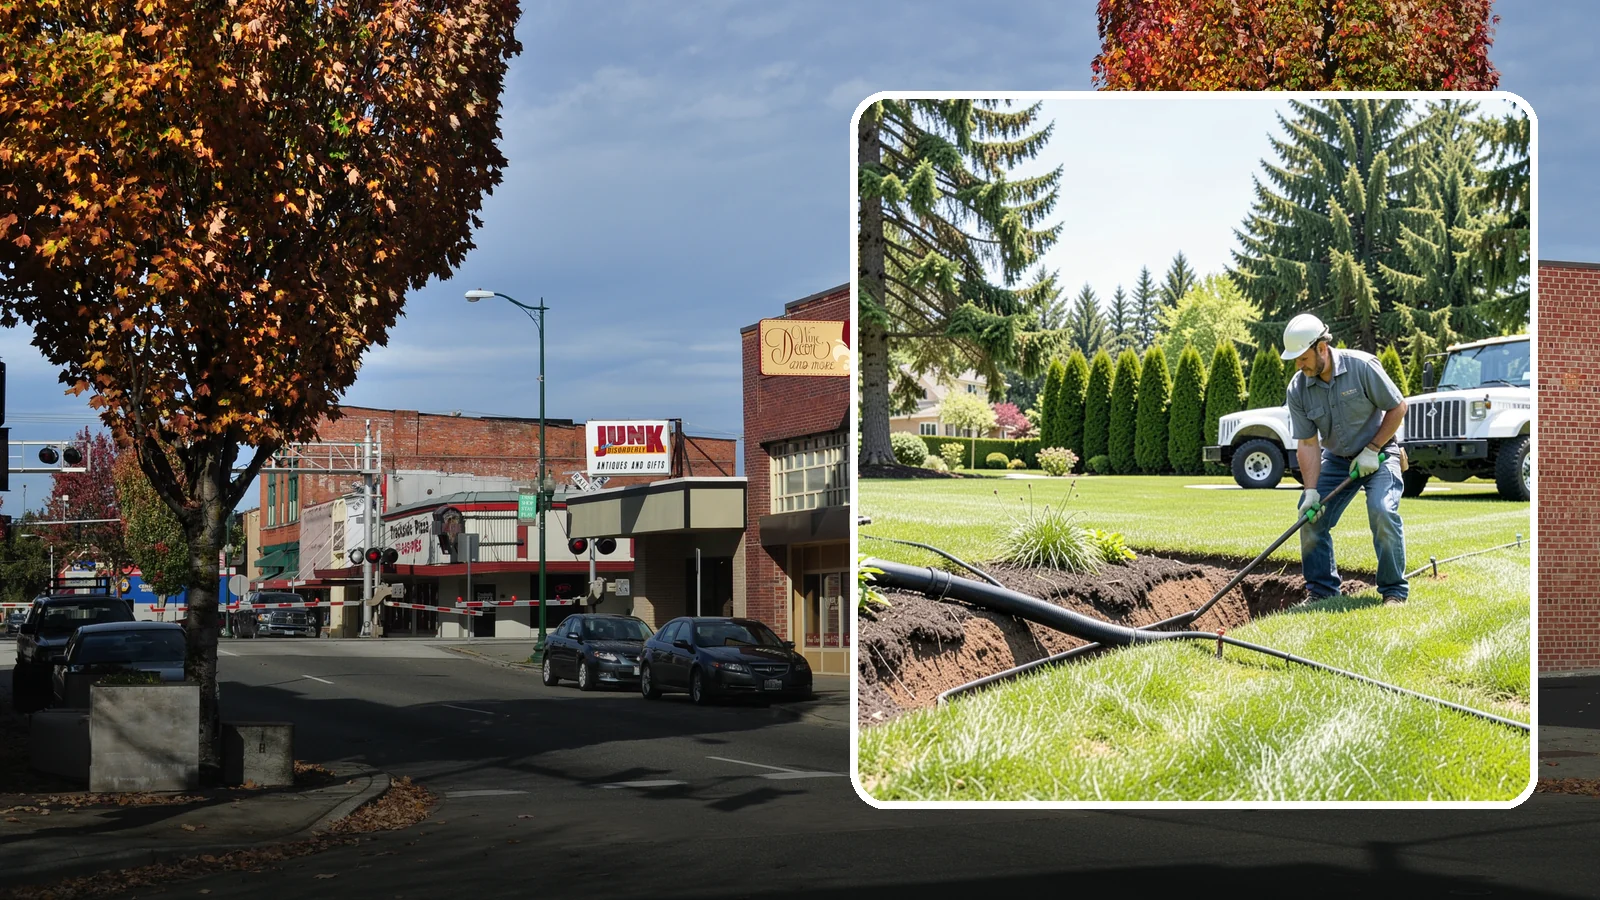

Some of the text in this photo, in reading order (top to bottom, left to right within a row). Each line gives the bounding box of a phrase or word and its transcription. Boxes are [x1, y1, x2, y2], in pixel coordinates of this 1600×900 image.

[596, 425, 665, 457] JUNK
[607, 445, 646, 454] DISORDERLY
[597, 460, 665, 470] ANTIQUES AND GIFTS
[390, 519, 429, 540] Trackside Pizza
